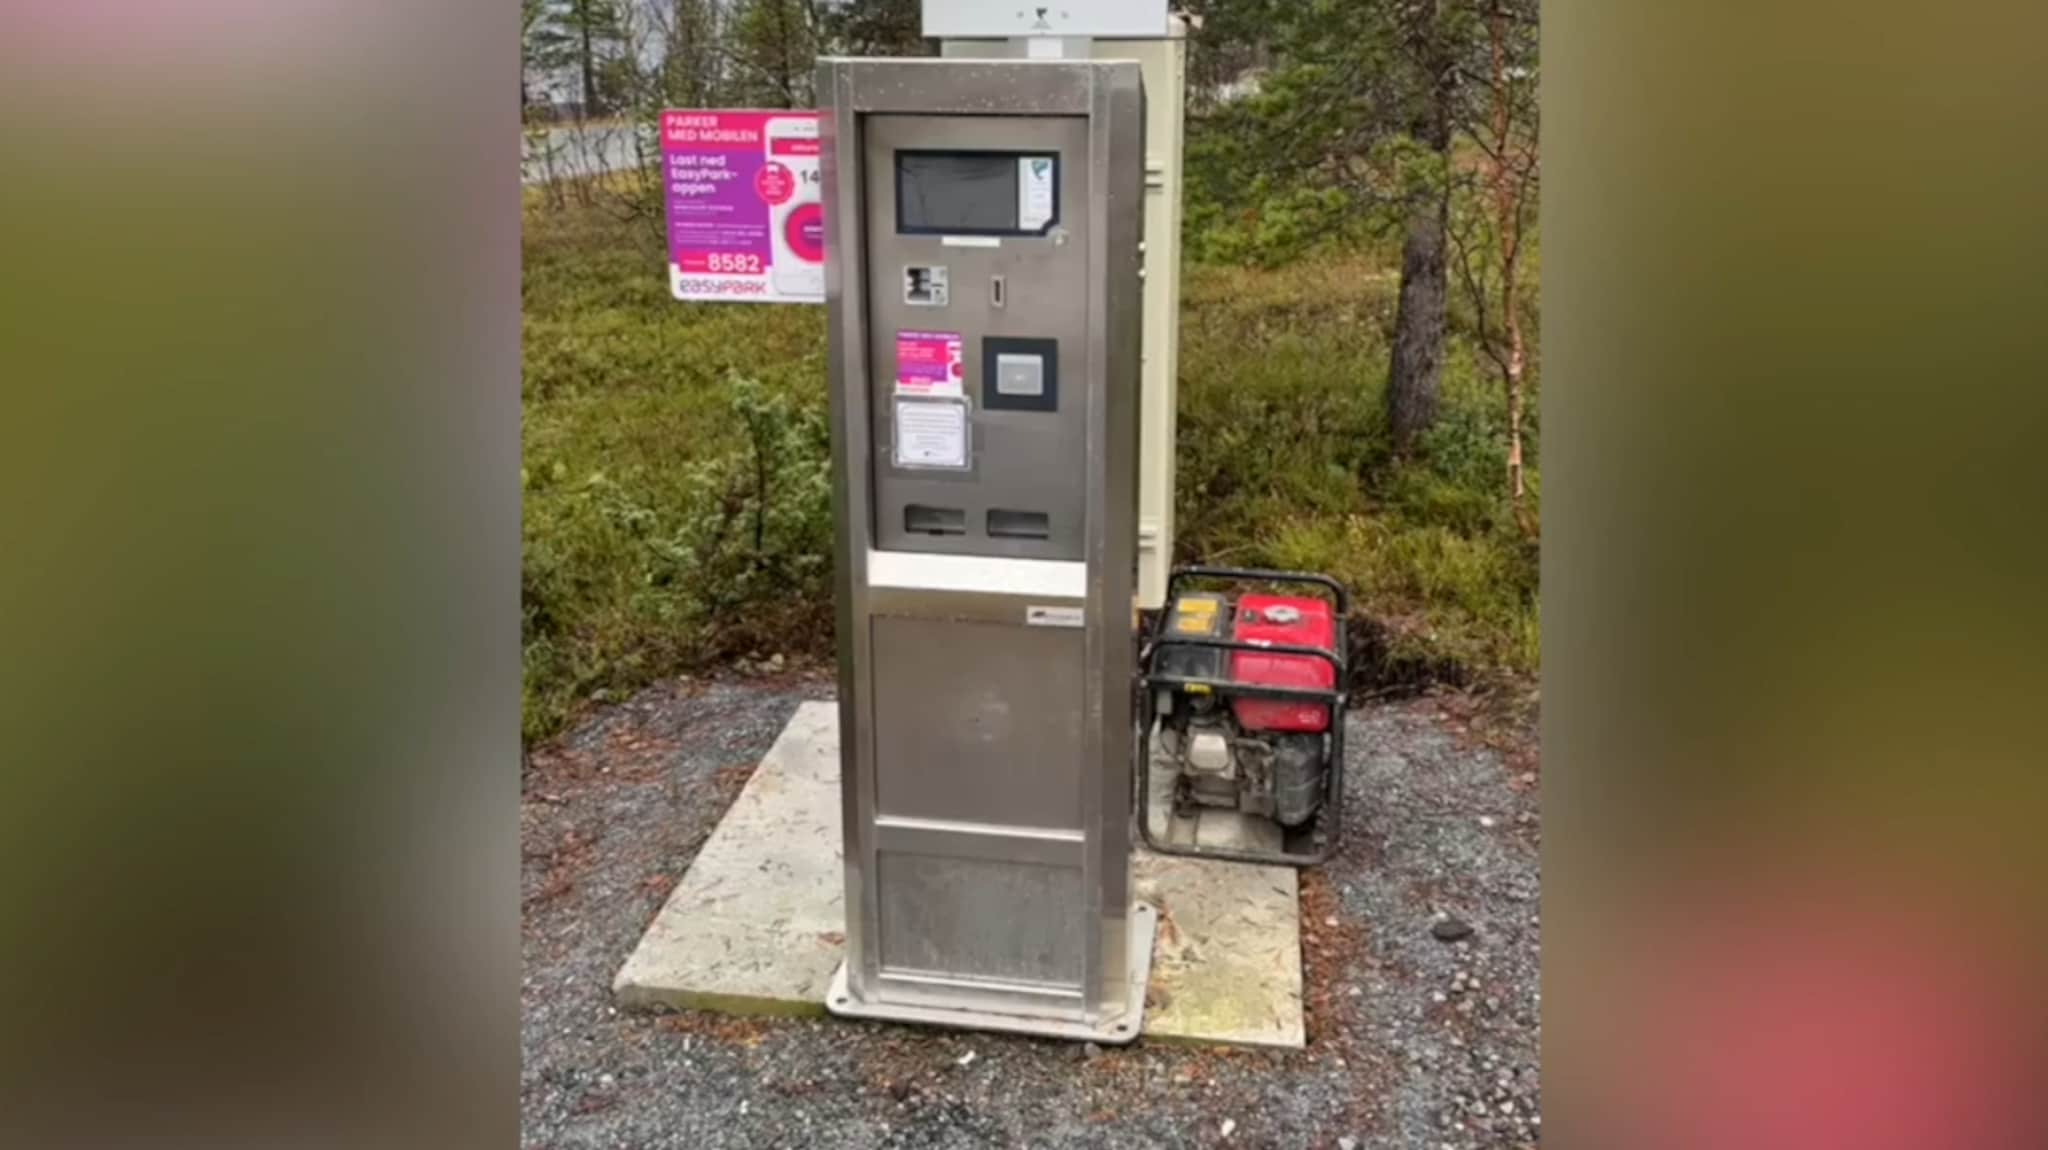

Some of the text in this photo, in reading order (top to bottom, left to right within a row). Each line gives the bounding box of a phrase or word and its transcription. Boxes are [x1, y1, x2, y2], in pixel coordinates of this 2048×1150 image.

[666, 115, 718, 127] PARKER
[668, 128, 758, 142] MED MOBILEN
[669, 153, 727, 167] Last ned
[672, 183, 716, 196] appen
[708, 252, 760, 273] 8582
